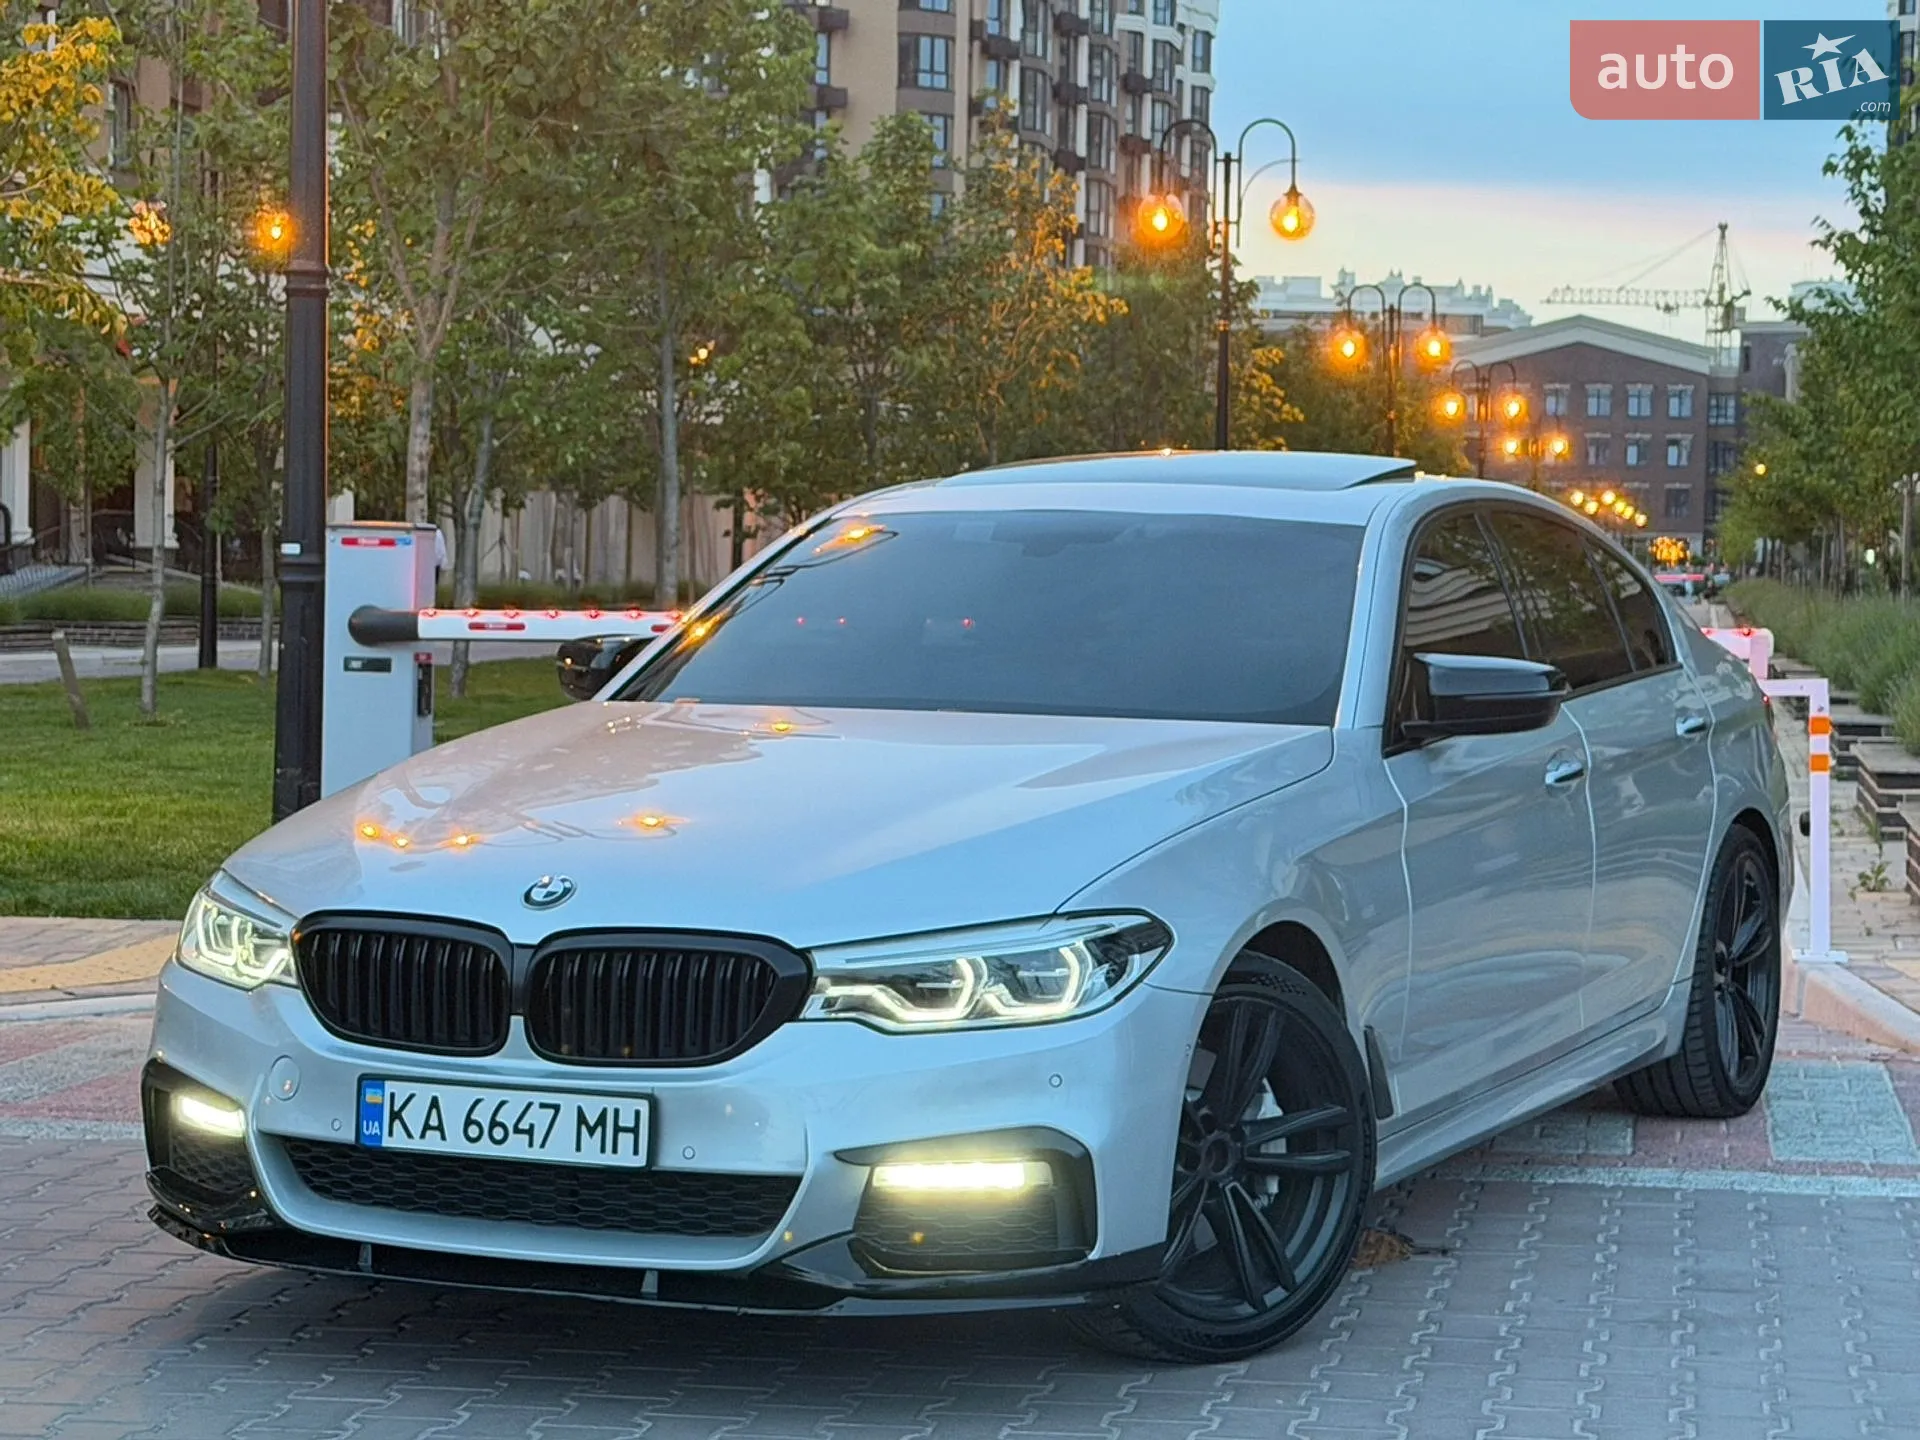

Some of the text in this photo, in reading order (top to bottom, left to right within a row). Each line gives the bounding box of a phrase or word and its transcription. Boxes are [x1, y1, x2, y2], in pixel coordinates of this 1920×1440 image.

[363, 1119, 381, 1136] UA
[387, 1092, 641, 1156] KA 6647 MH
